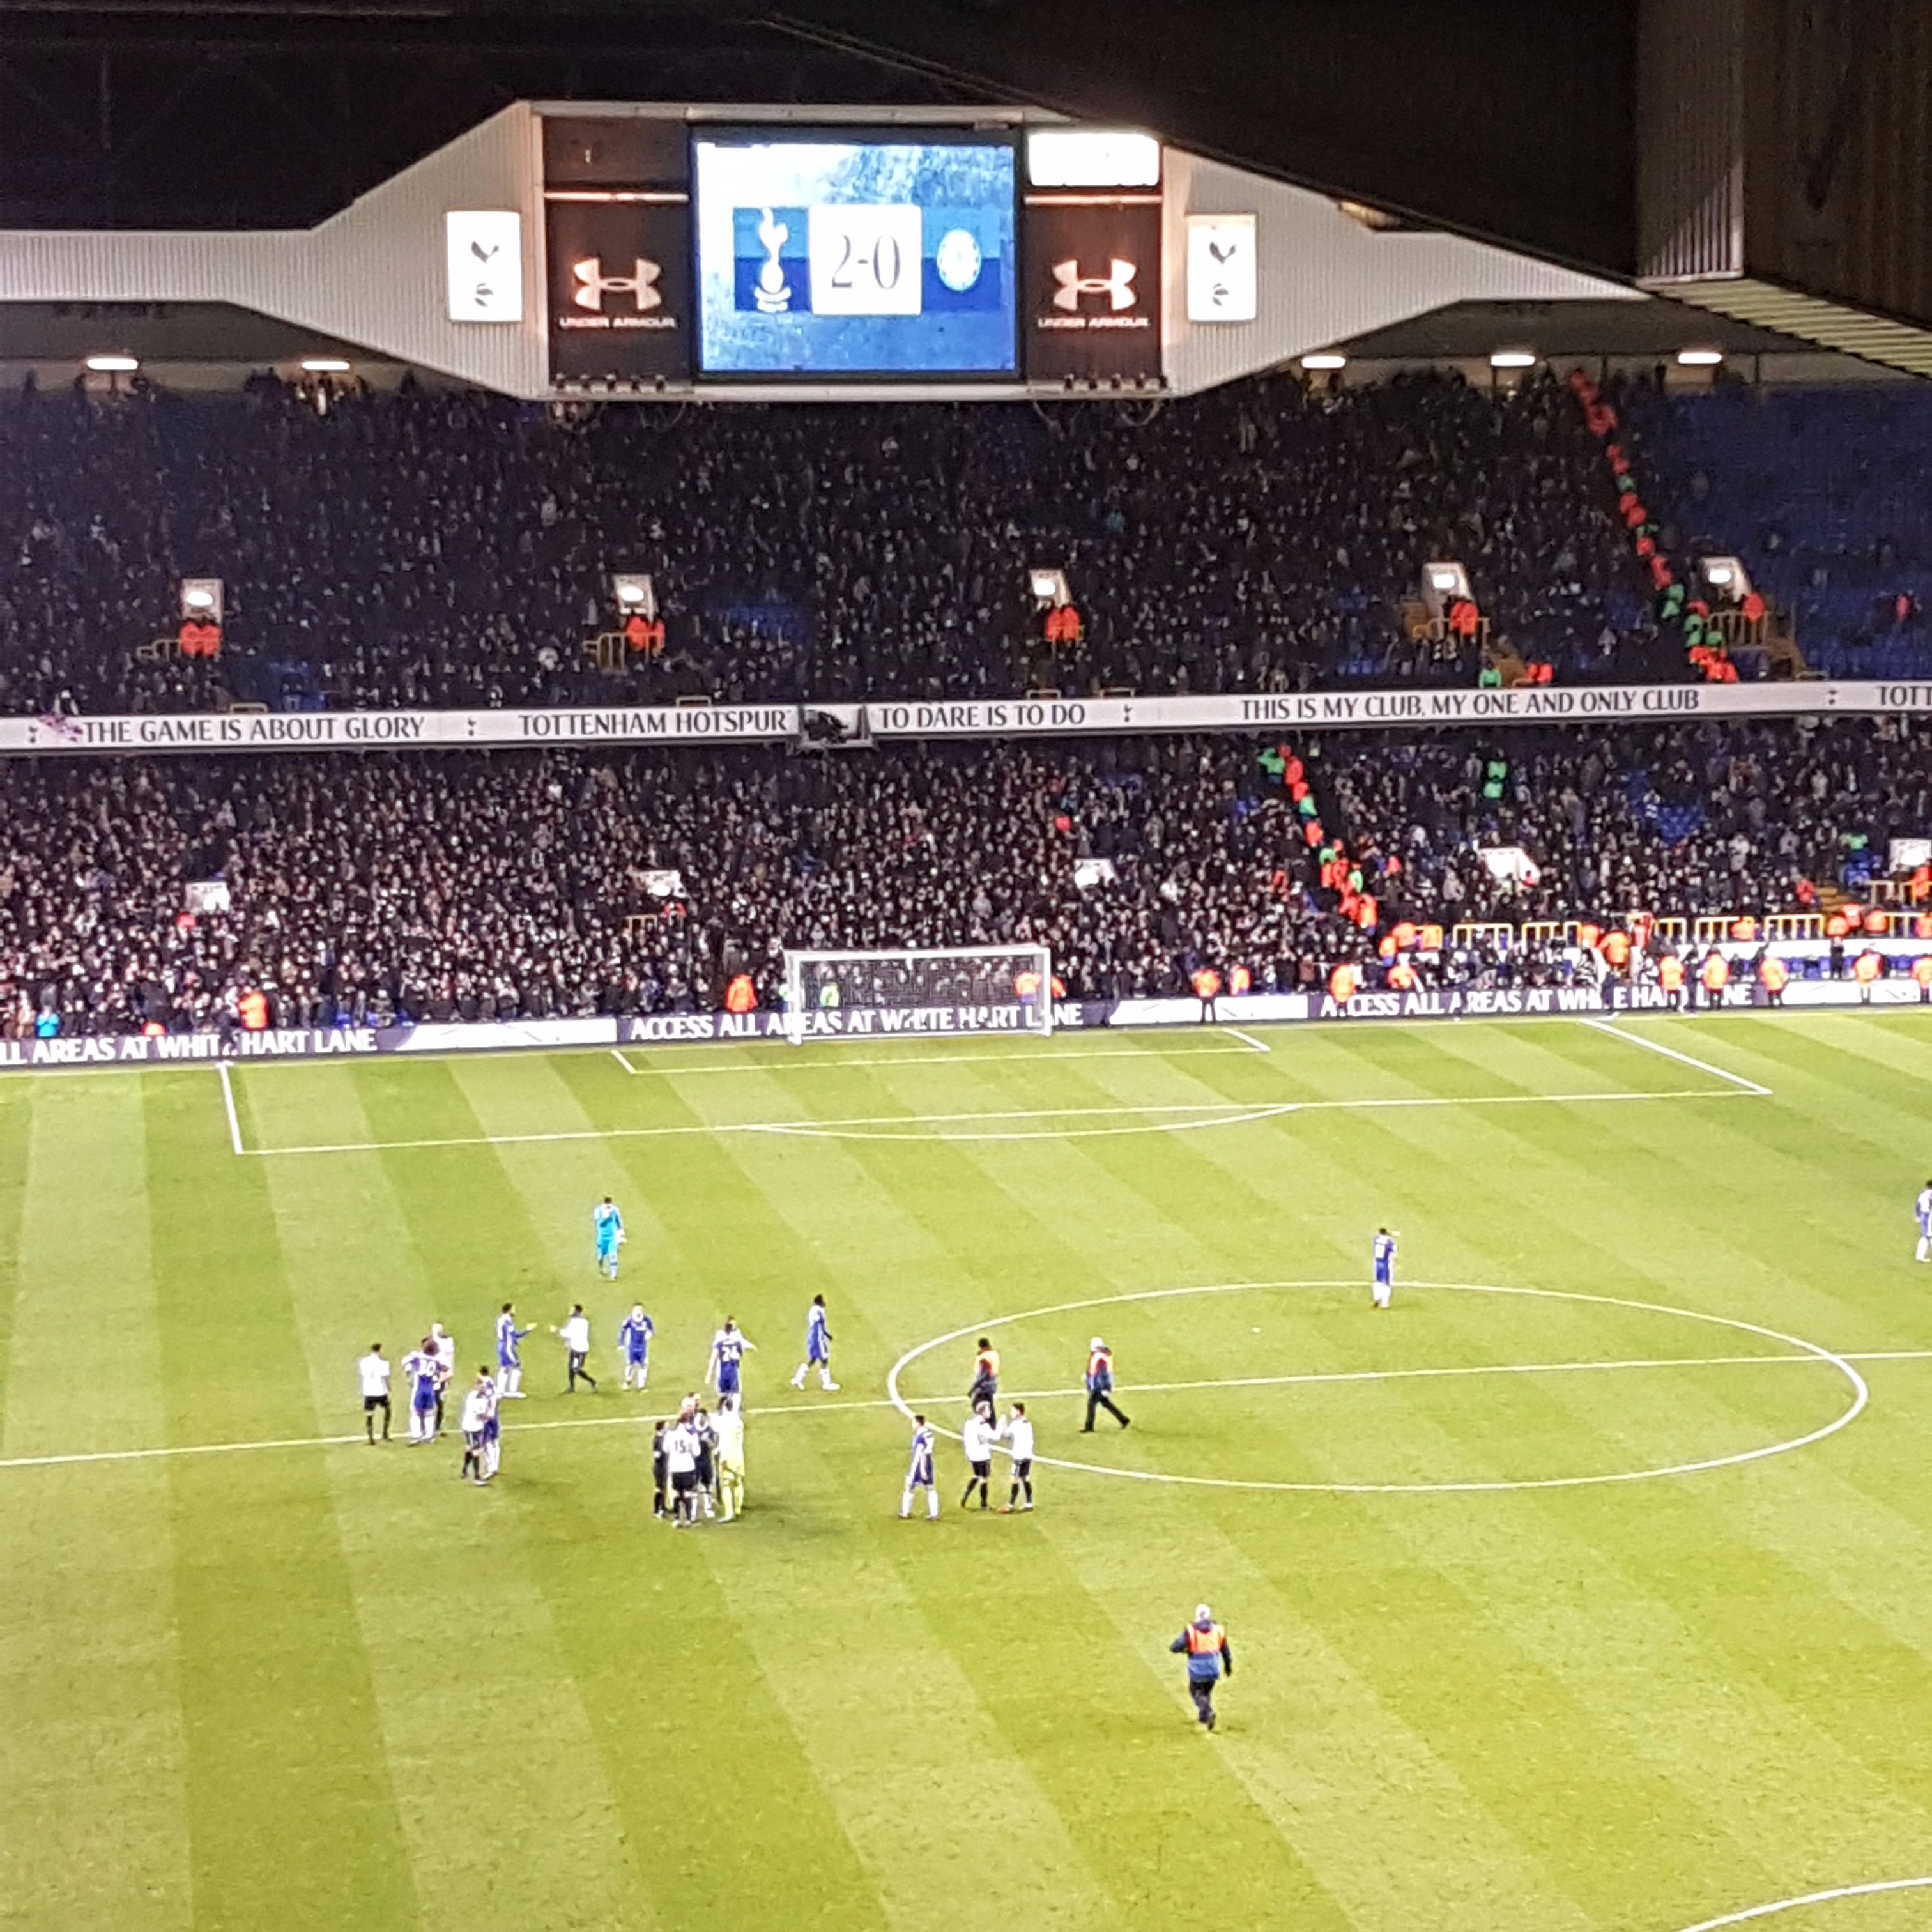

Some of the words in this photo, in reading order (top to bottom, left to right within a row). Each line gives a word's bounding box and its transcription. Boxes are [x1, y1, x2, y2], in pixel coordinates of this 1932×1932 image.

[832, 233, 901, 289] 2-0
[879, 707, 908, 729] TO
[918, 705, 979, 728] DARE
[988, 705, 1007, 726] IS
[1013, 704, 1044, 726] TO
[1052, 703, 1085, 724] DO
[1241, 698, 1289, 720] THIS
[1298, 697, 1317, 719] IS
[1323, 696, 1358, 718] MY
[1432, 694, 1467, 715] MY
[1473, 693, 1519, 714] ONE
[1525, 692, 1574, 713] AND
[1581, 691, 1637, 712] ONLY
[1643, 689, 1699, 710] CLUB
[82, 721, 130, 743] THE
[141, 719, 211, 742] GAME
[221, 719, 241, 740] IS
[250, 717, 337, 740] ABOUT
[346, 716, 424, 739] GLORY
[519, 713, 666, 735] TOTTENHAM
[676, 711, 787, 733] HOTSPUR
[1321, 993, 1400, 1016] ACESS
[1405, 992, 1444, 1014] ALL
[1527, 988, 1552, 1011] AT
[1557, 986, 1627, 1010] WHIE
[1696, 983, 1751, 1005] LNE
[630, 1015, 714, 1040] ACCESS
[719, 1013, 761, 1037] ALL
[847, 1009, 875, 1032] AT
[959, 1006, 1020, 1028] HART
[33, 1037, 116, 1063] AREAS
[121, 1036, 151, 1060] AT
[155, 1032, 237, 1058] WHIT
[241, 1030, 310, 1054] HART
[314, 1029, 377, 1053] LANE
